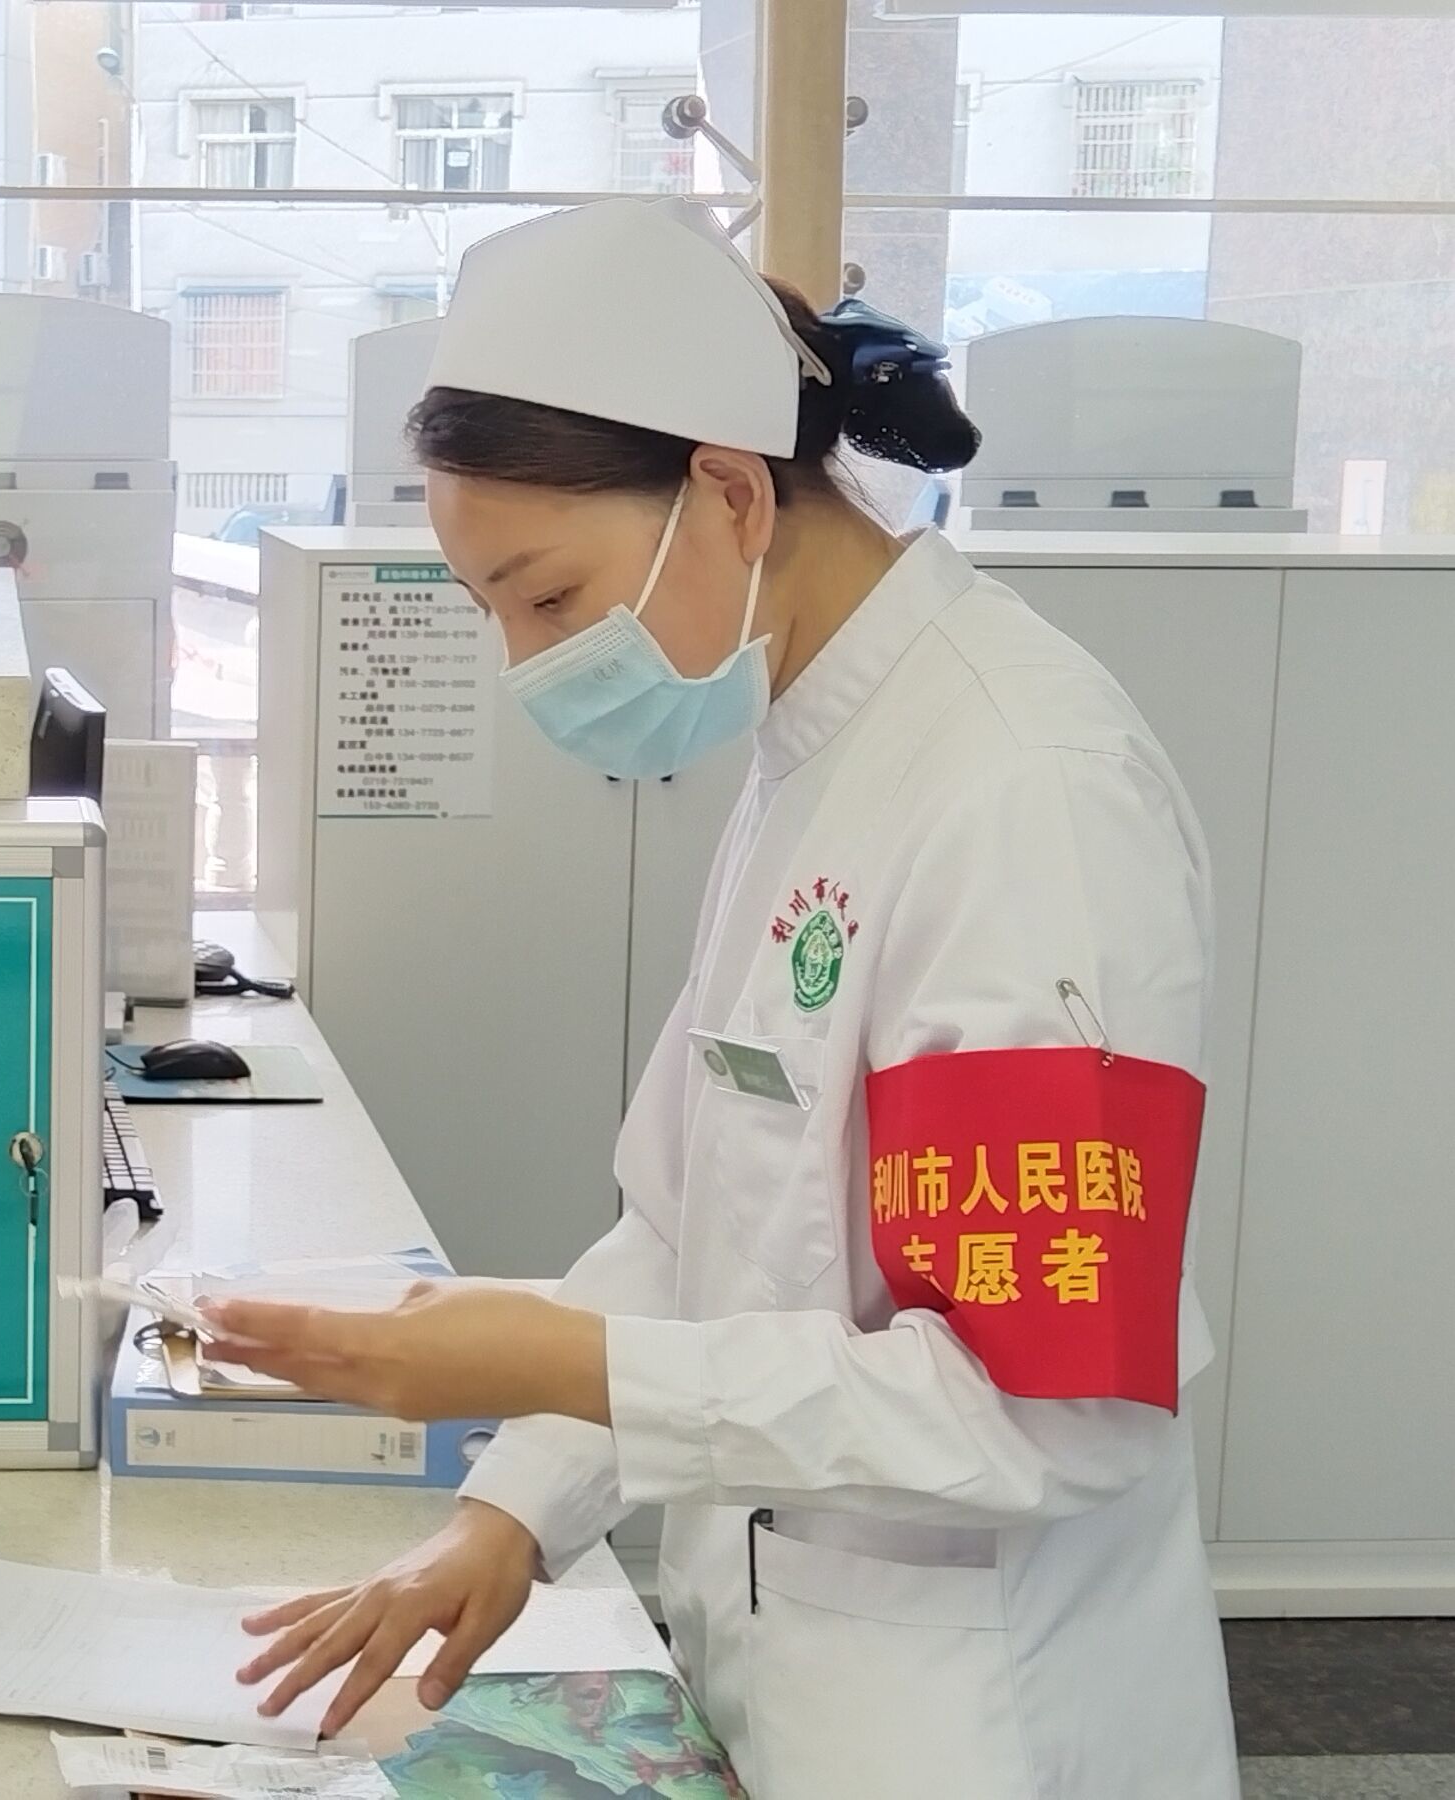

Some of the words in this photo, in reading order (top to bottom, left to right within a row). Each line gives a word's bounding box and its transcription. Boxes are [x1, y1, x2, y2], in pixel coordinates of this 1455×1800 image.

[873, 1141, 1146, 1224] 利川市人民医院
